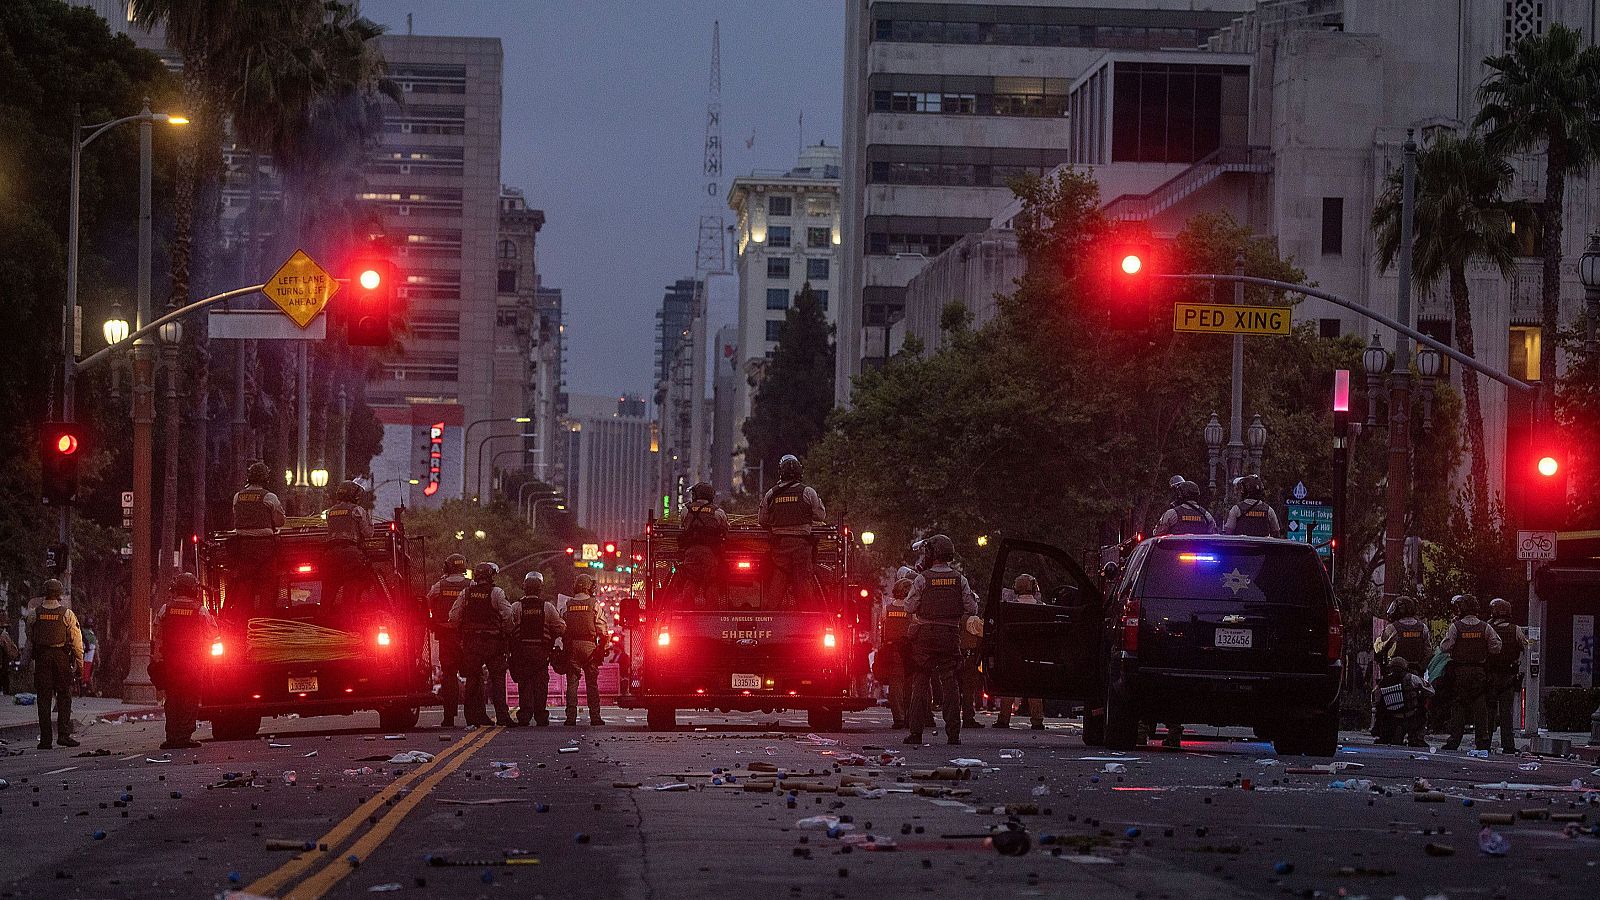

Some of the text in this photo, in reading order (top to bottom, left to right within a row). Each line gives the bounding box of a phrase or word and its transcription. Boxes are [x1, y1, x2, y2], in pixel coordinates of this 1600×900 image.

[278, 275, 324, 285] LEFT LANE
[277, 287, 304, 296] TURNS
[288, 297, 317, 306] AHEAD
[1184, 308, 1281, 330] PED XING
[430, 428, 442, 482] PARK
[239, 493, 260, 501] SHERIFF
[775, 496, 799, 504] SHERIFF
[1317, 511, 1333, 520] Tokyo
[931, 578, 956, 586] SHERIFF
[170, 608, 194, 616] SHERIFF
[722, 630, 772, 639] SHERIFF
[1217, 634, 1250, 645] 1326456
